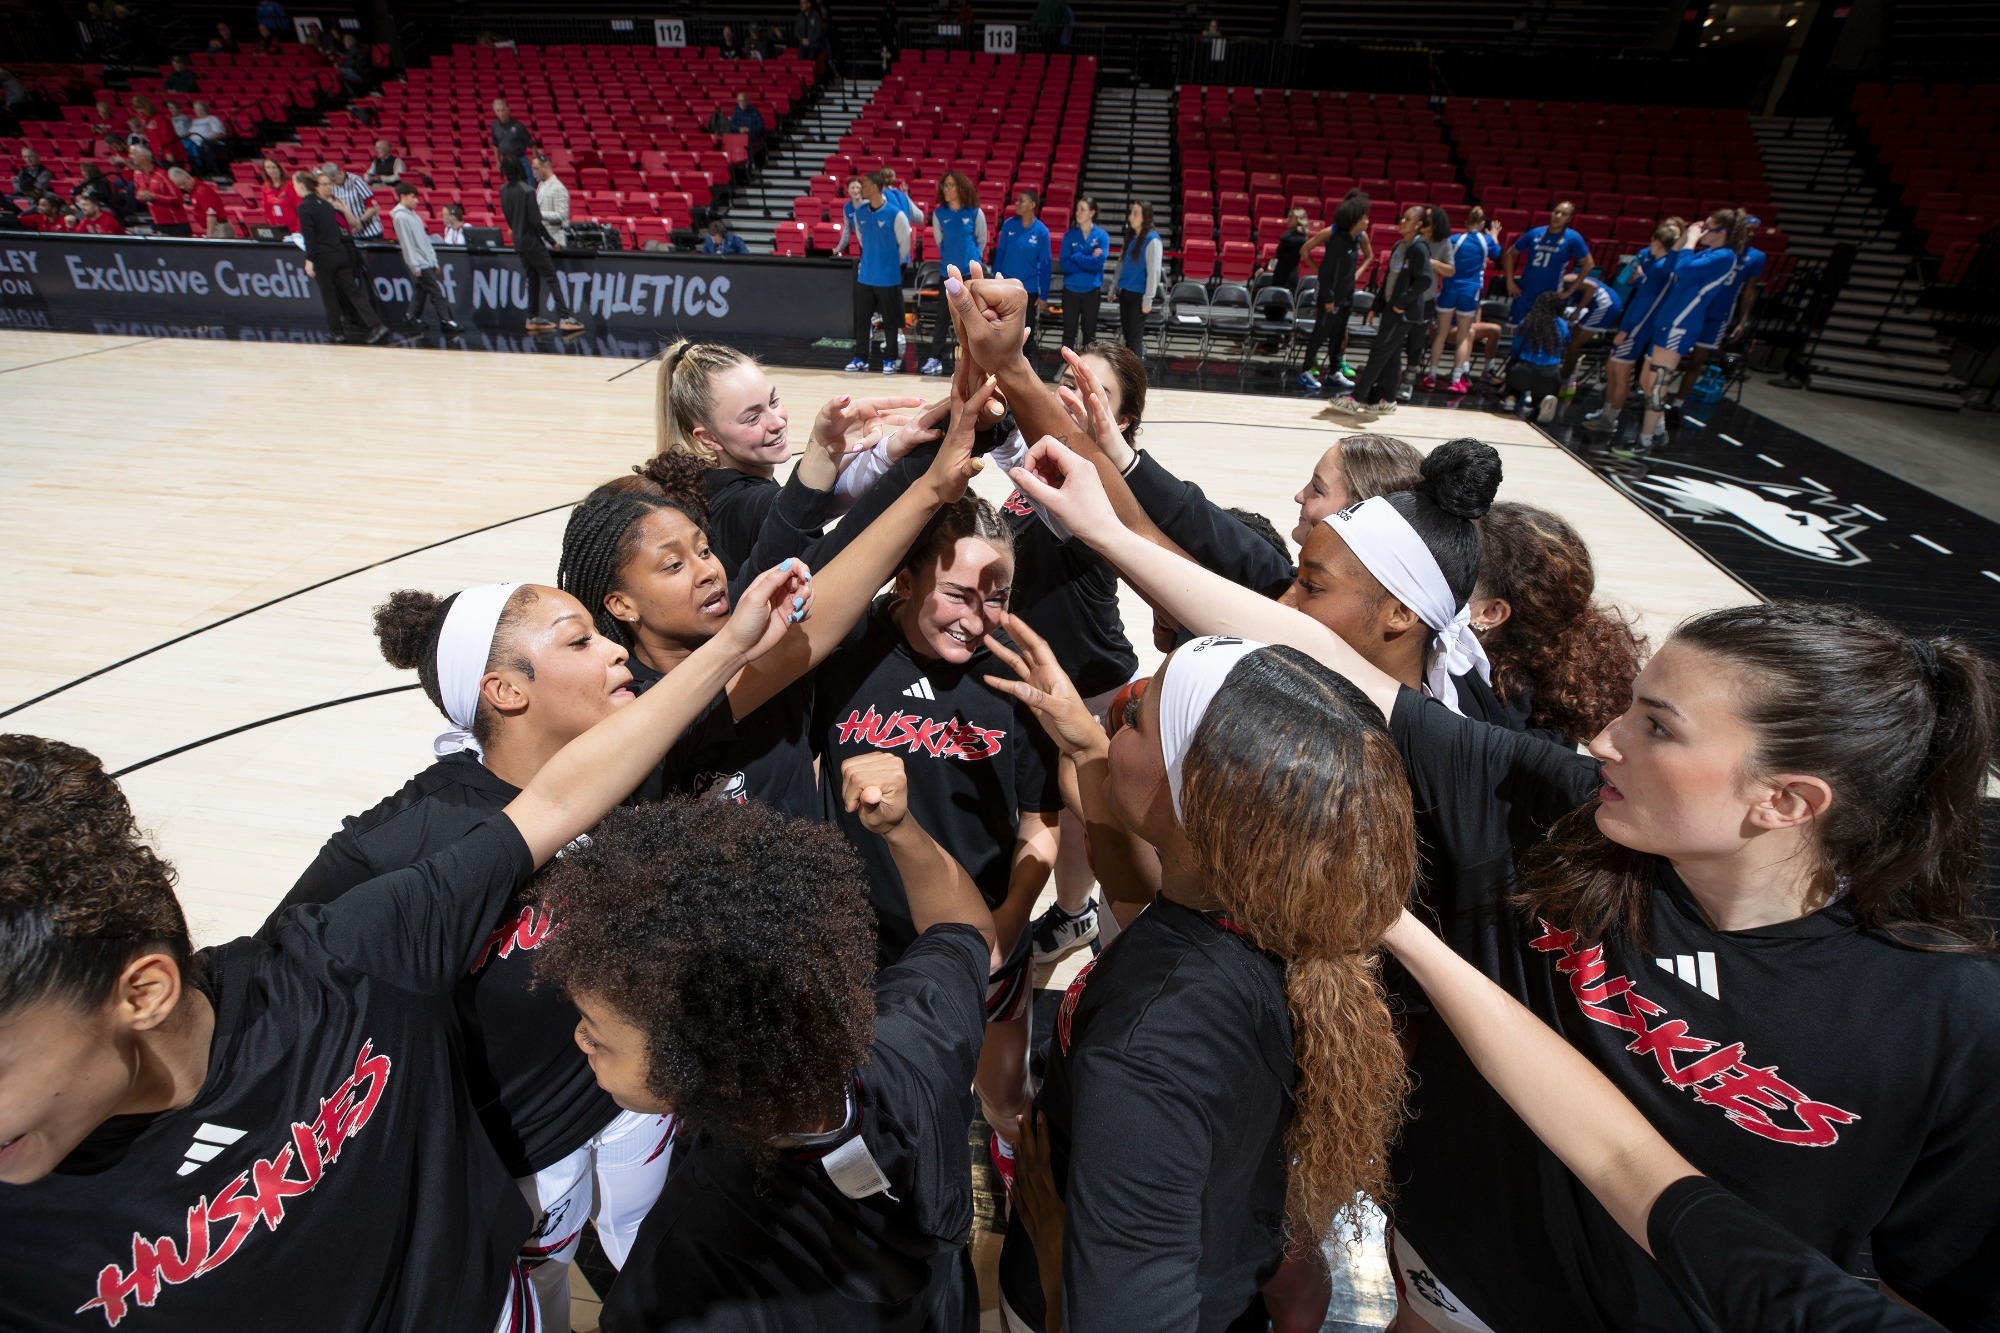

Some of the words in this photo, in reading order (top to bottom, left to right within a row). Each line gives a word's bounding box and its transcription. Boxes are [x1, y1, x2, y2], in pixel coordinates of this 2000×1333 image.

[658, 25, 683, 42] 112
[988, 30, 1013, 48] 113
[1532, 251, 1551, 267] 21
[0, 278, 34, 296] ON
[64, 252, 210, 296] Exclusive
[214, 258, 311, 299] Credit
[472, 268, 529, 310] NIU
[836, 703, 1007, 761] HUSKIES
[1529, 917, 1862, 1148] HUSKIES
[75, 1037, 392, 1328] HUSKIES
